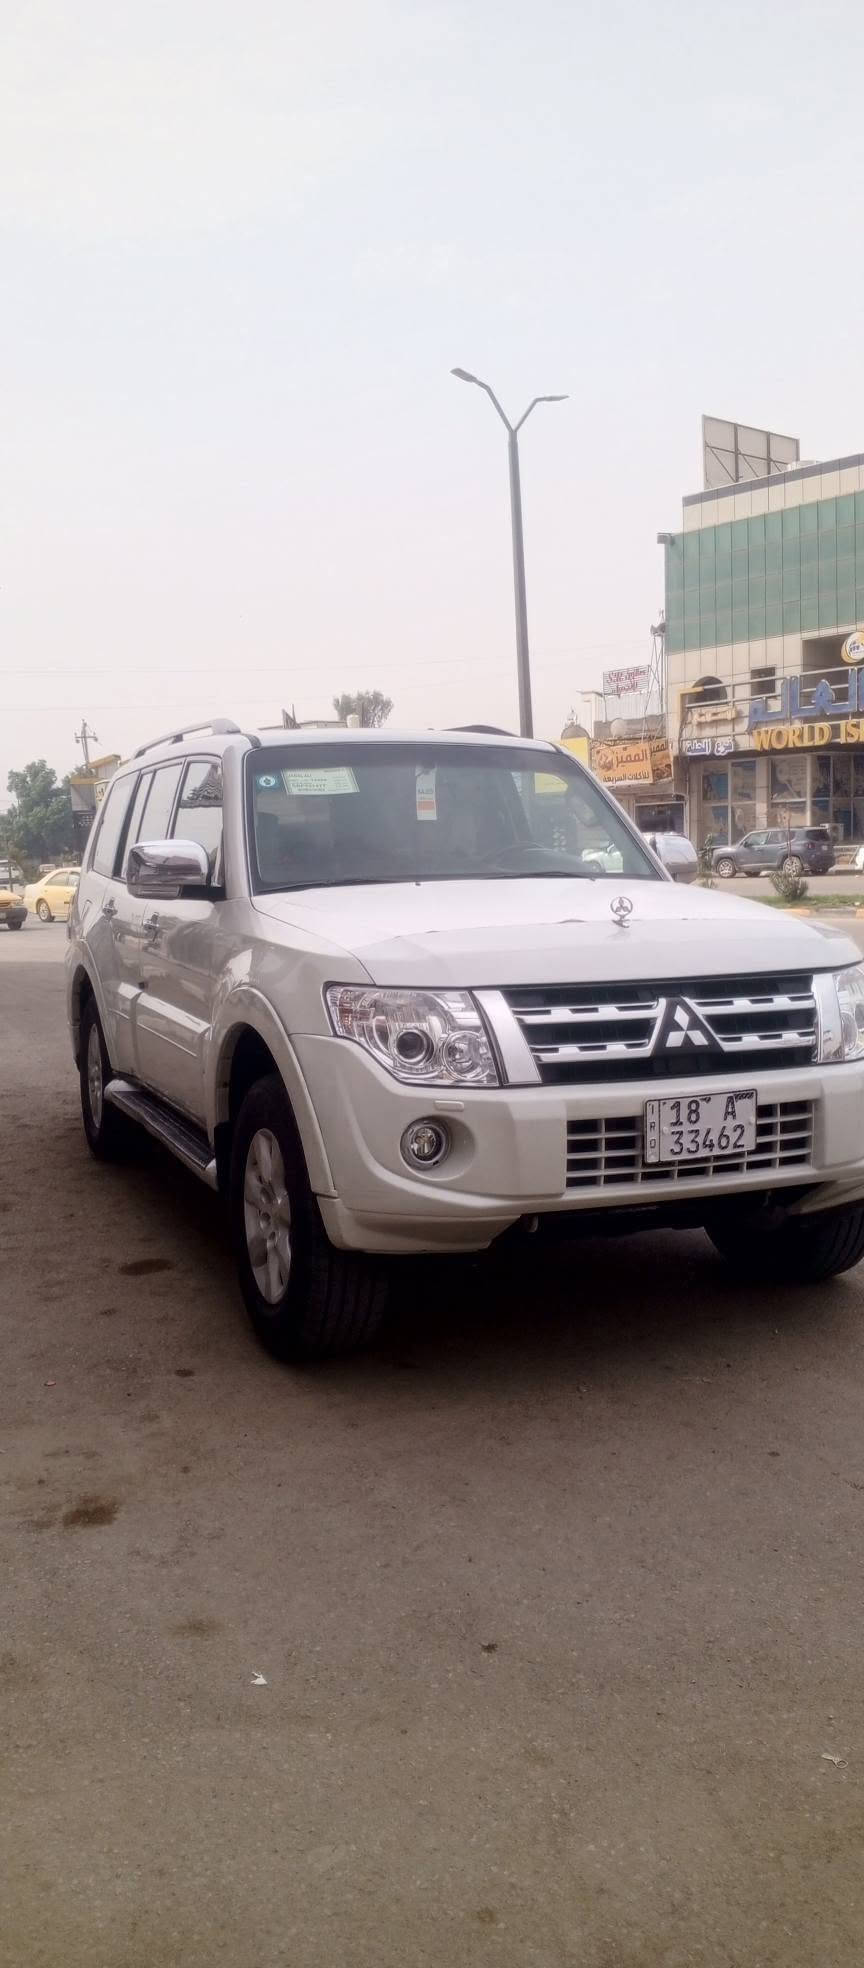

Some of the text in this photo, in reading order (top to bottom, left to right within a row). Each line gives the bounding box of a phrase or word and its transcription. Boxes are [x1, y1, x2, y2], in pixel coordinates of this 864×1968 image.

[752, 722, 832, 751] WORLD
[670, 1095, 737, 1127] 18 A
[669, 1123, 746, 1156] 33462
